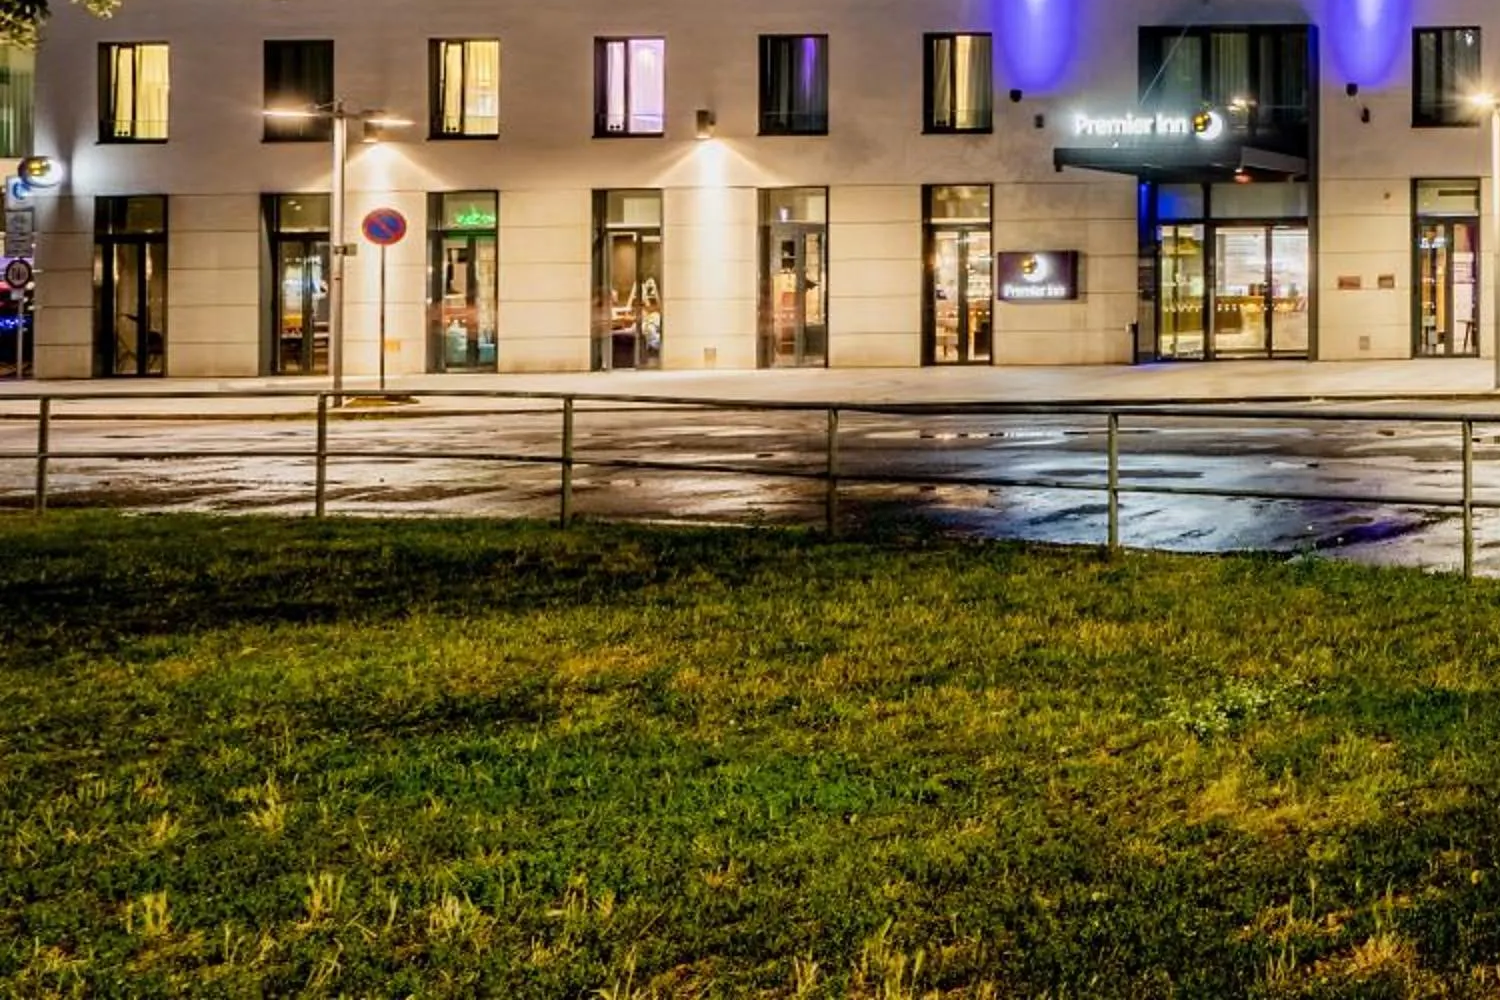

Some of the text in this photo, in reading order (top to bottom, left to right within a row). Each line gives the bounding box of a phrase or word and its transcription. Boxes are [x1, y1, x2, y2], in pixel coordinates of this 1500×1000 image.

[1074, 112, 1188, 135] Premier Inn
[1003, 283, 1046, 298] Premier
